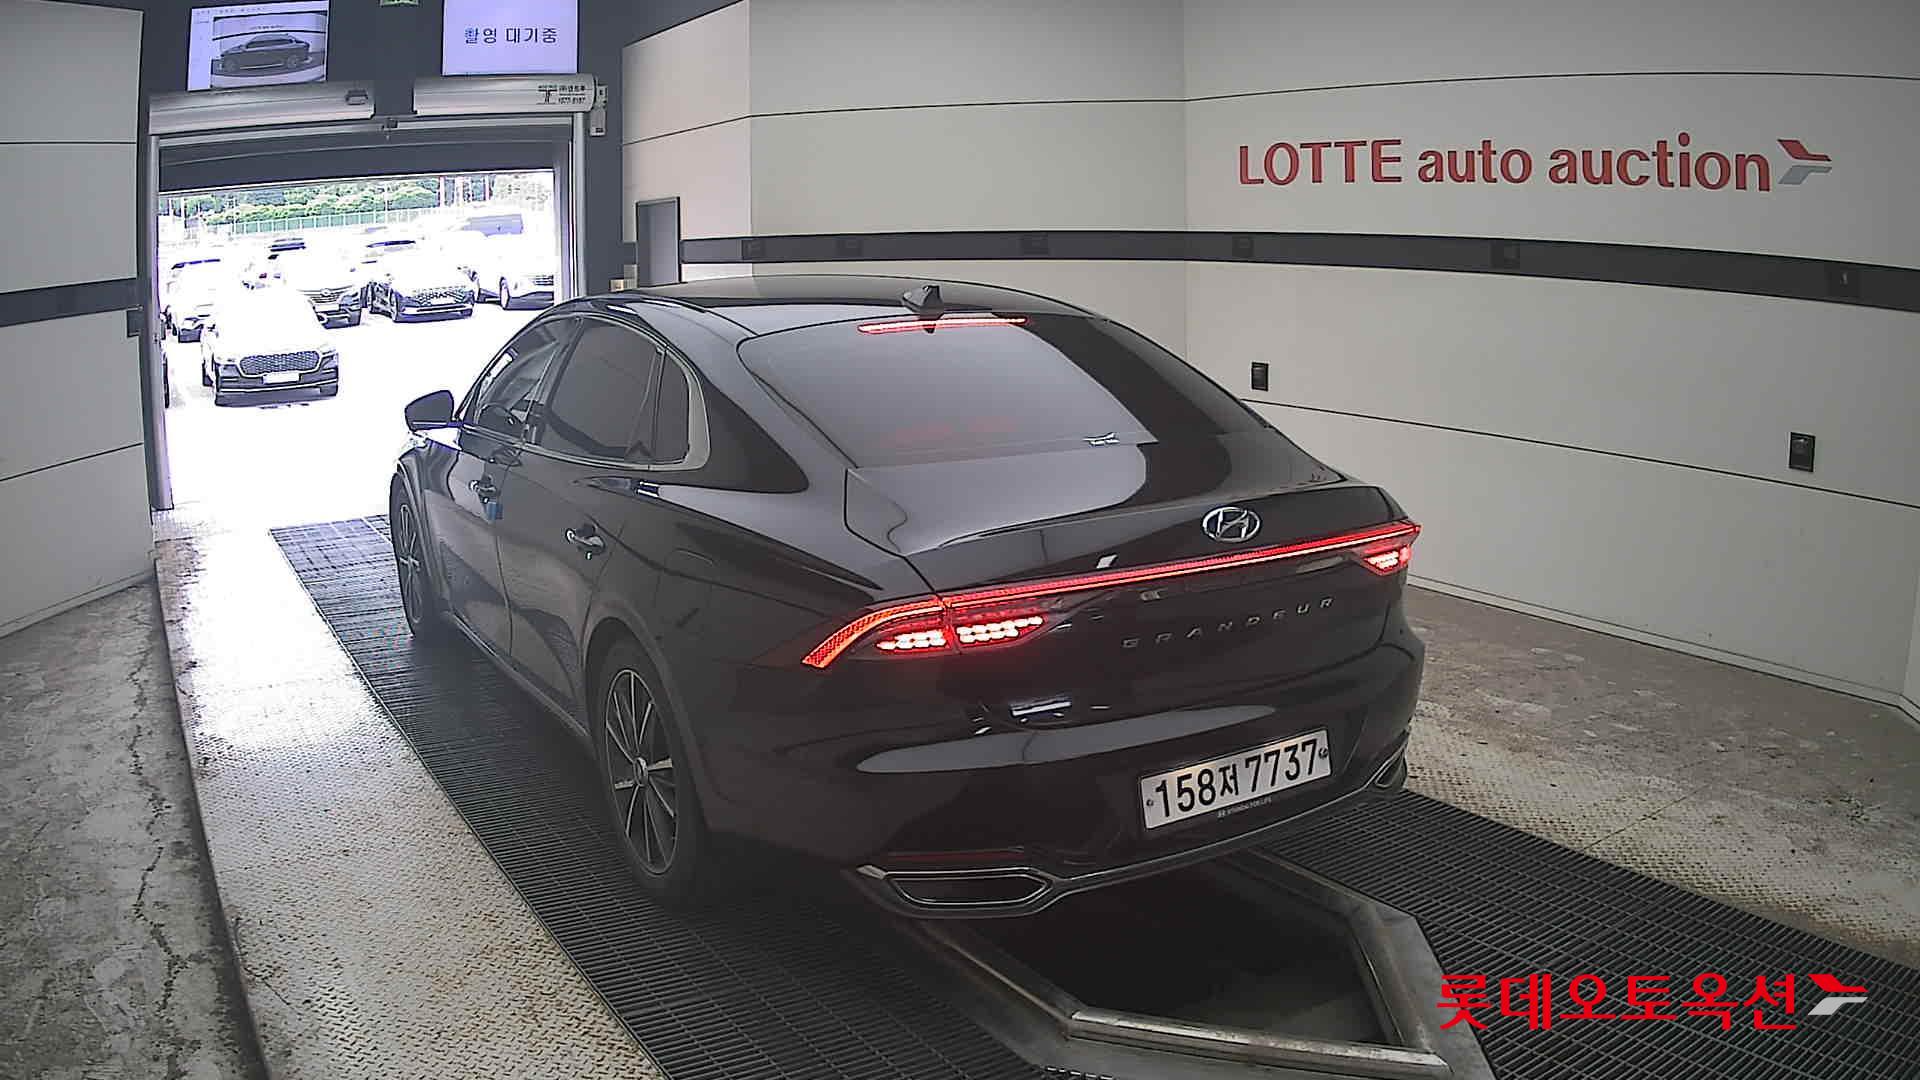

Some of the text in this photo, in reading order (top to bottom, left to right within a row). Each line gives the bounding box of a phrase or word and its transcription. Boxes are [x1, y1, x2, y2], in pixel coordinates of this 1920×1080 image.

[505, 27, 558, 44] 대기중
[1238, 132, 1771, 192] LOTTE auto auction
[1121, 597, 1335, 649] GRANDEUR
